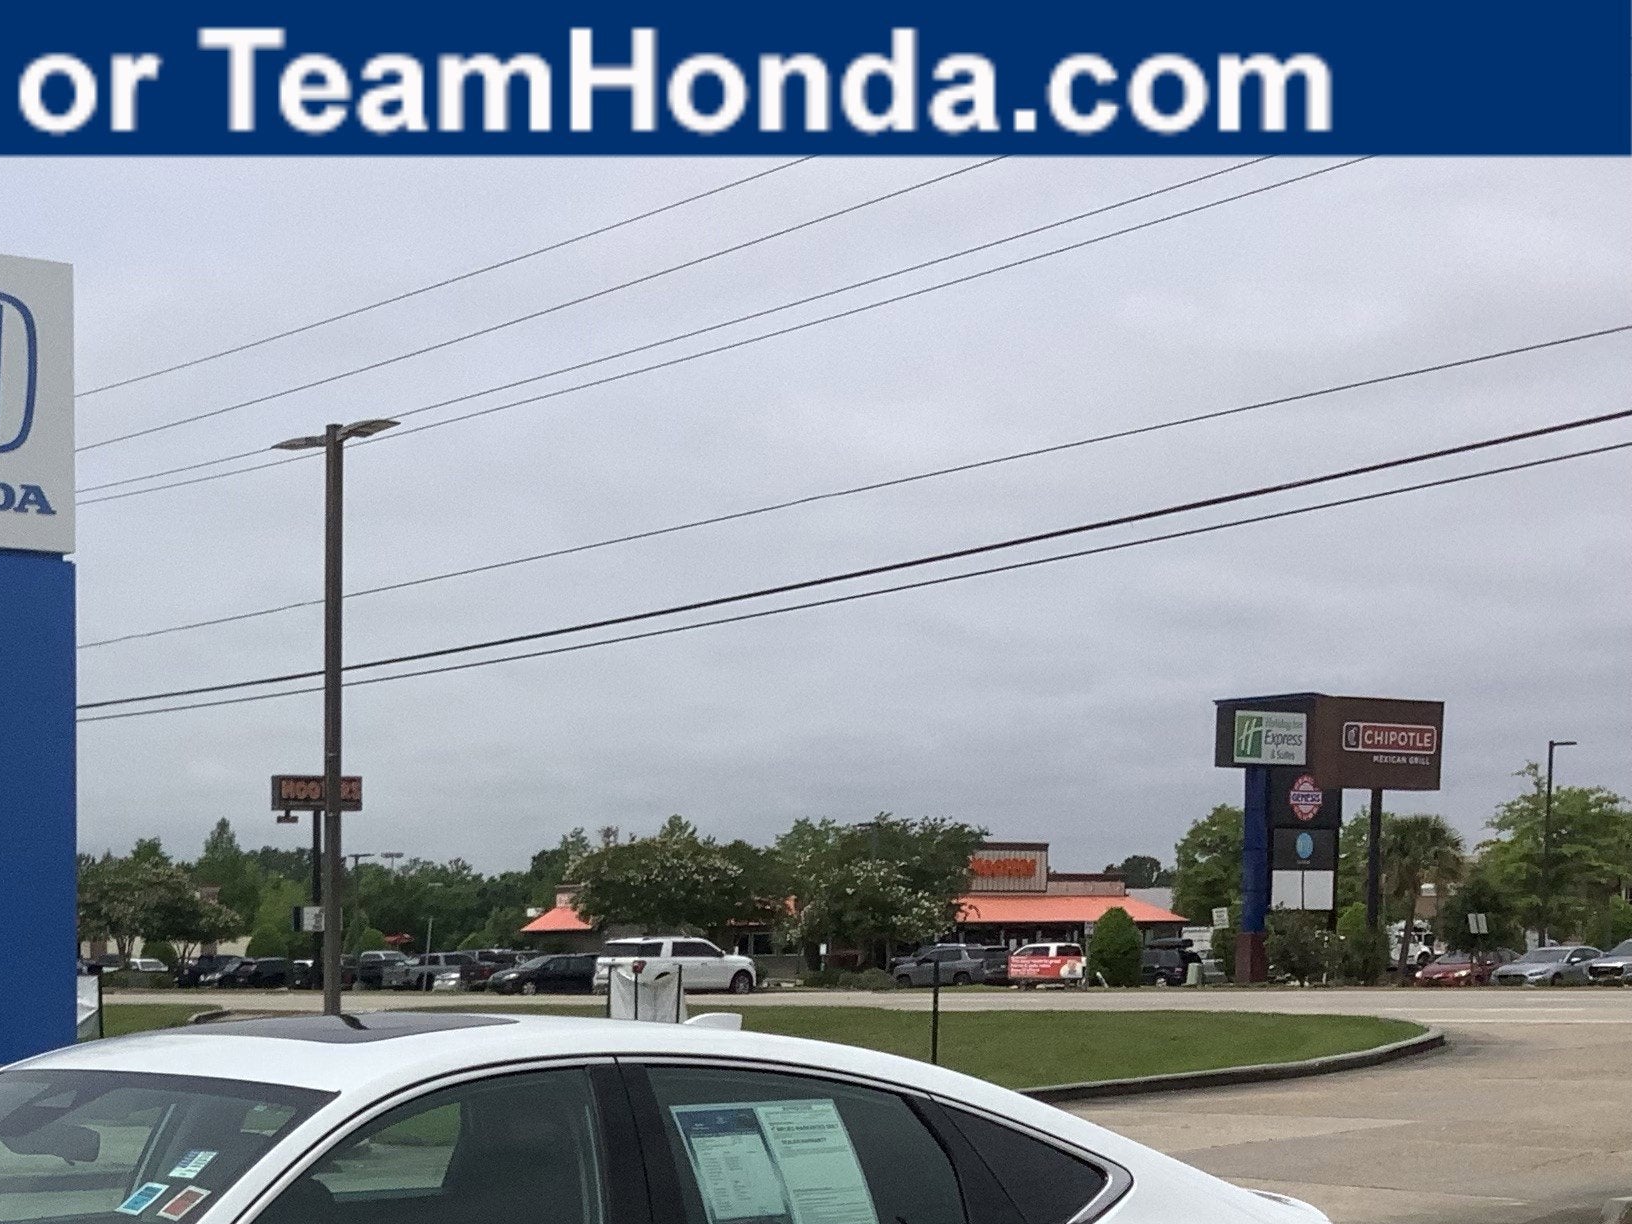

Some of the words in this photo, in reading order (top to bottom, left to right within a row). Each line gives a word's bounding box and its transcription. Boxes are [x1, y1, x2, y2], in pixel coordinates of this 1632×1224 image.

[1264, 729, 1303, 748] Express
[1364, 729, 1432, 748] CHIPOTLE
[1372, 755, 1407, 764] MEXICAN
[1408, 756, 1430, 766] GRILL
[281, 780, 361, 800] HOORS
